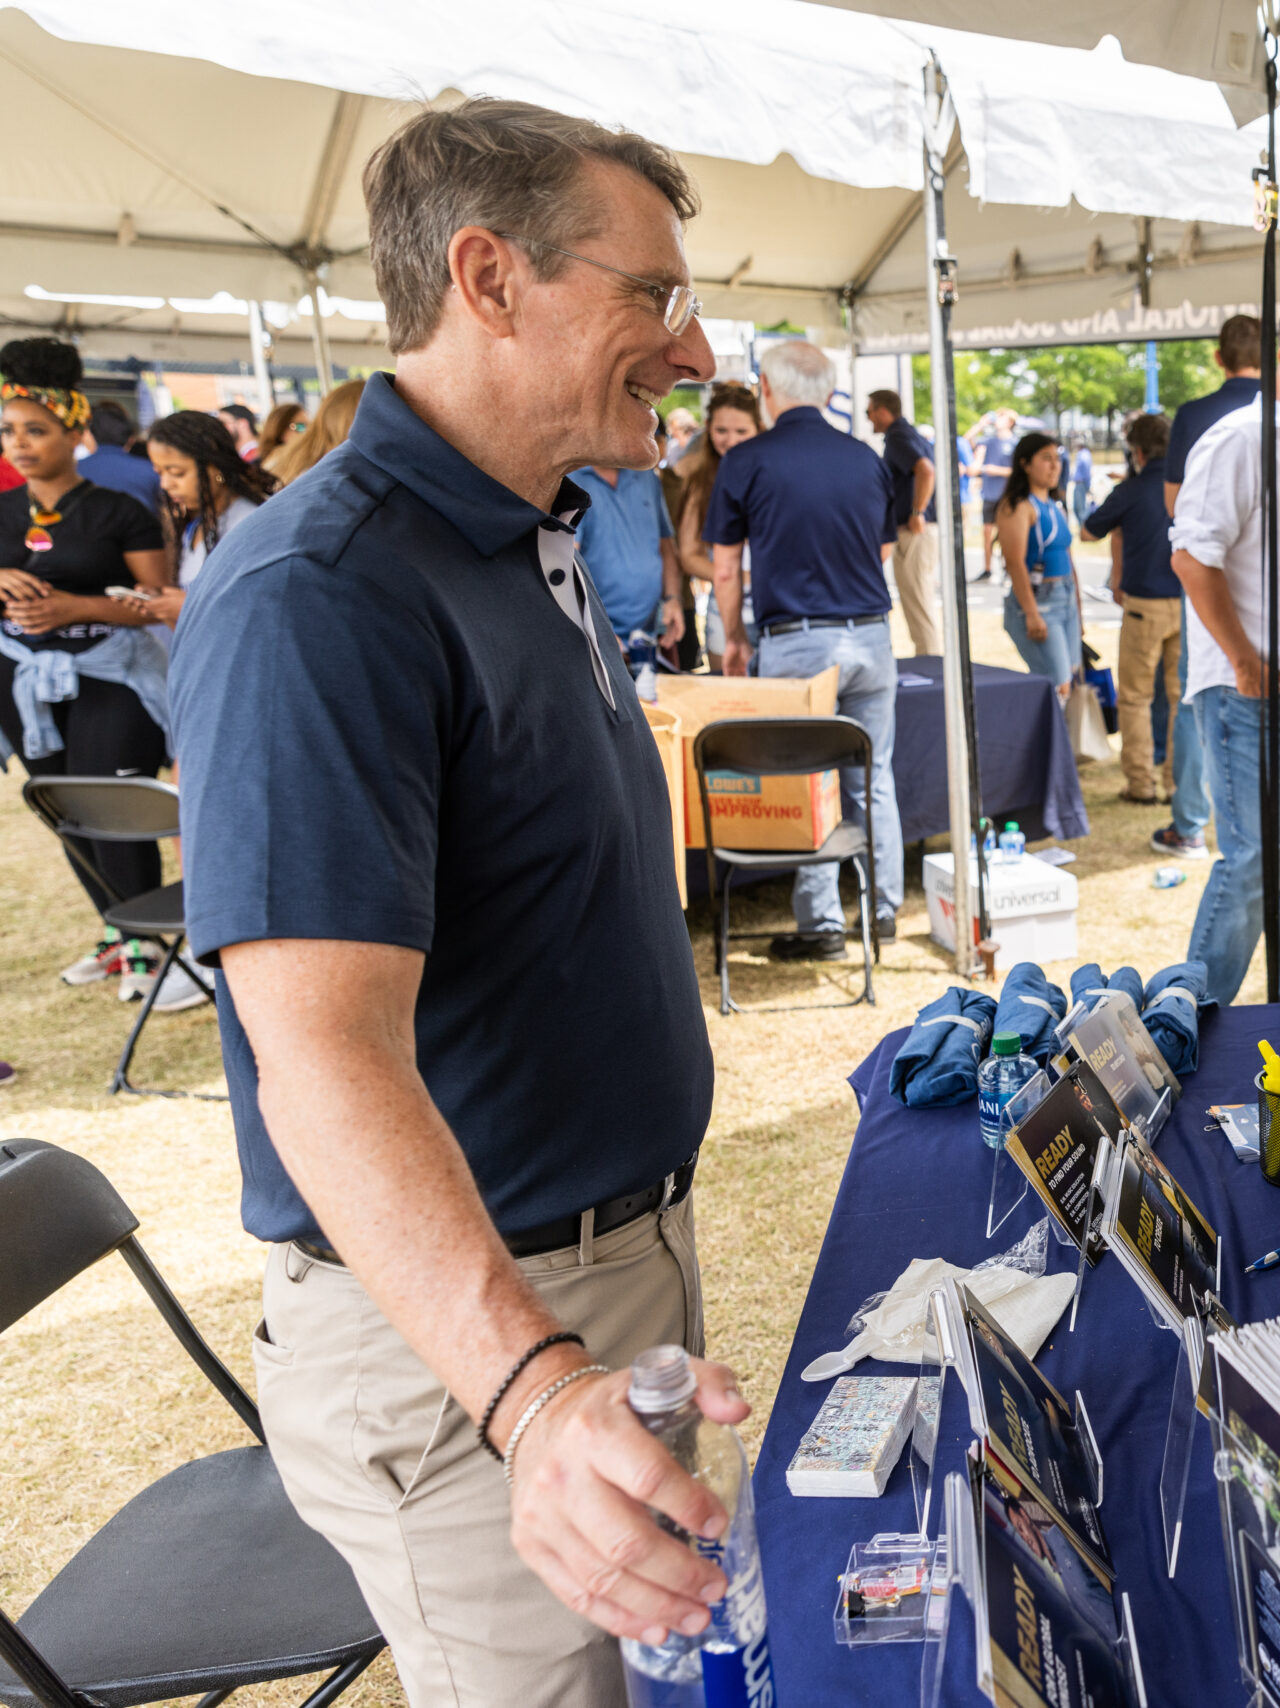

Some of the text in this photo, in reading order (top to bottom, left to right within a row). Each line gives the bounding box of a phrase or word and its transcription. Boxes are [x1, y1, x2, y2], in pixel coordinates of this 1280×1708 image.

[993, 885, 1061, 911] universal
[1089, 1035, 1117, 1073] READY
[1035, 1124, 1075, 1180] READY
[1048, 1143, 1086, 1191] TO FIND YOUR SOUND
[1137, 1195, 1155, 1263] READY
[998, 1378, 1032, 1473] READY
[1012, 1563, 1044, 1693] READY
